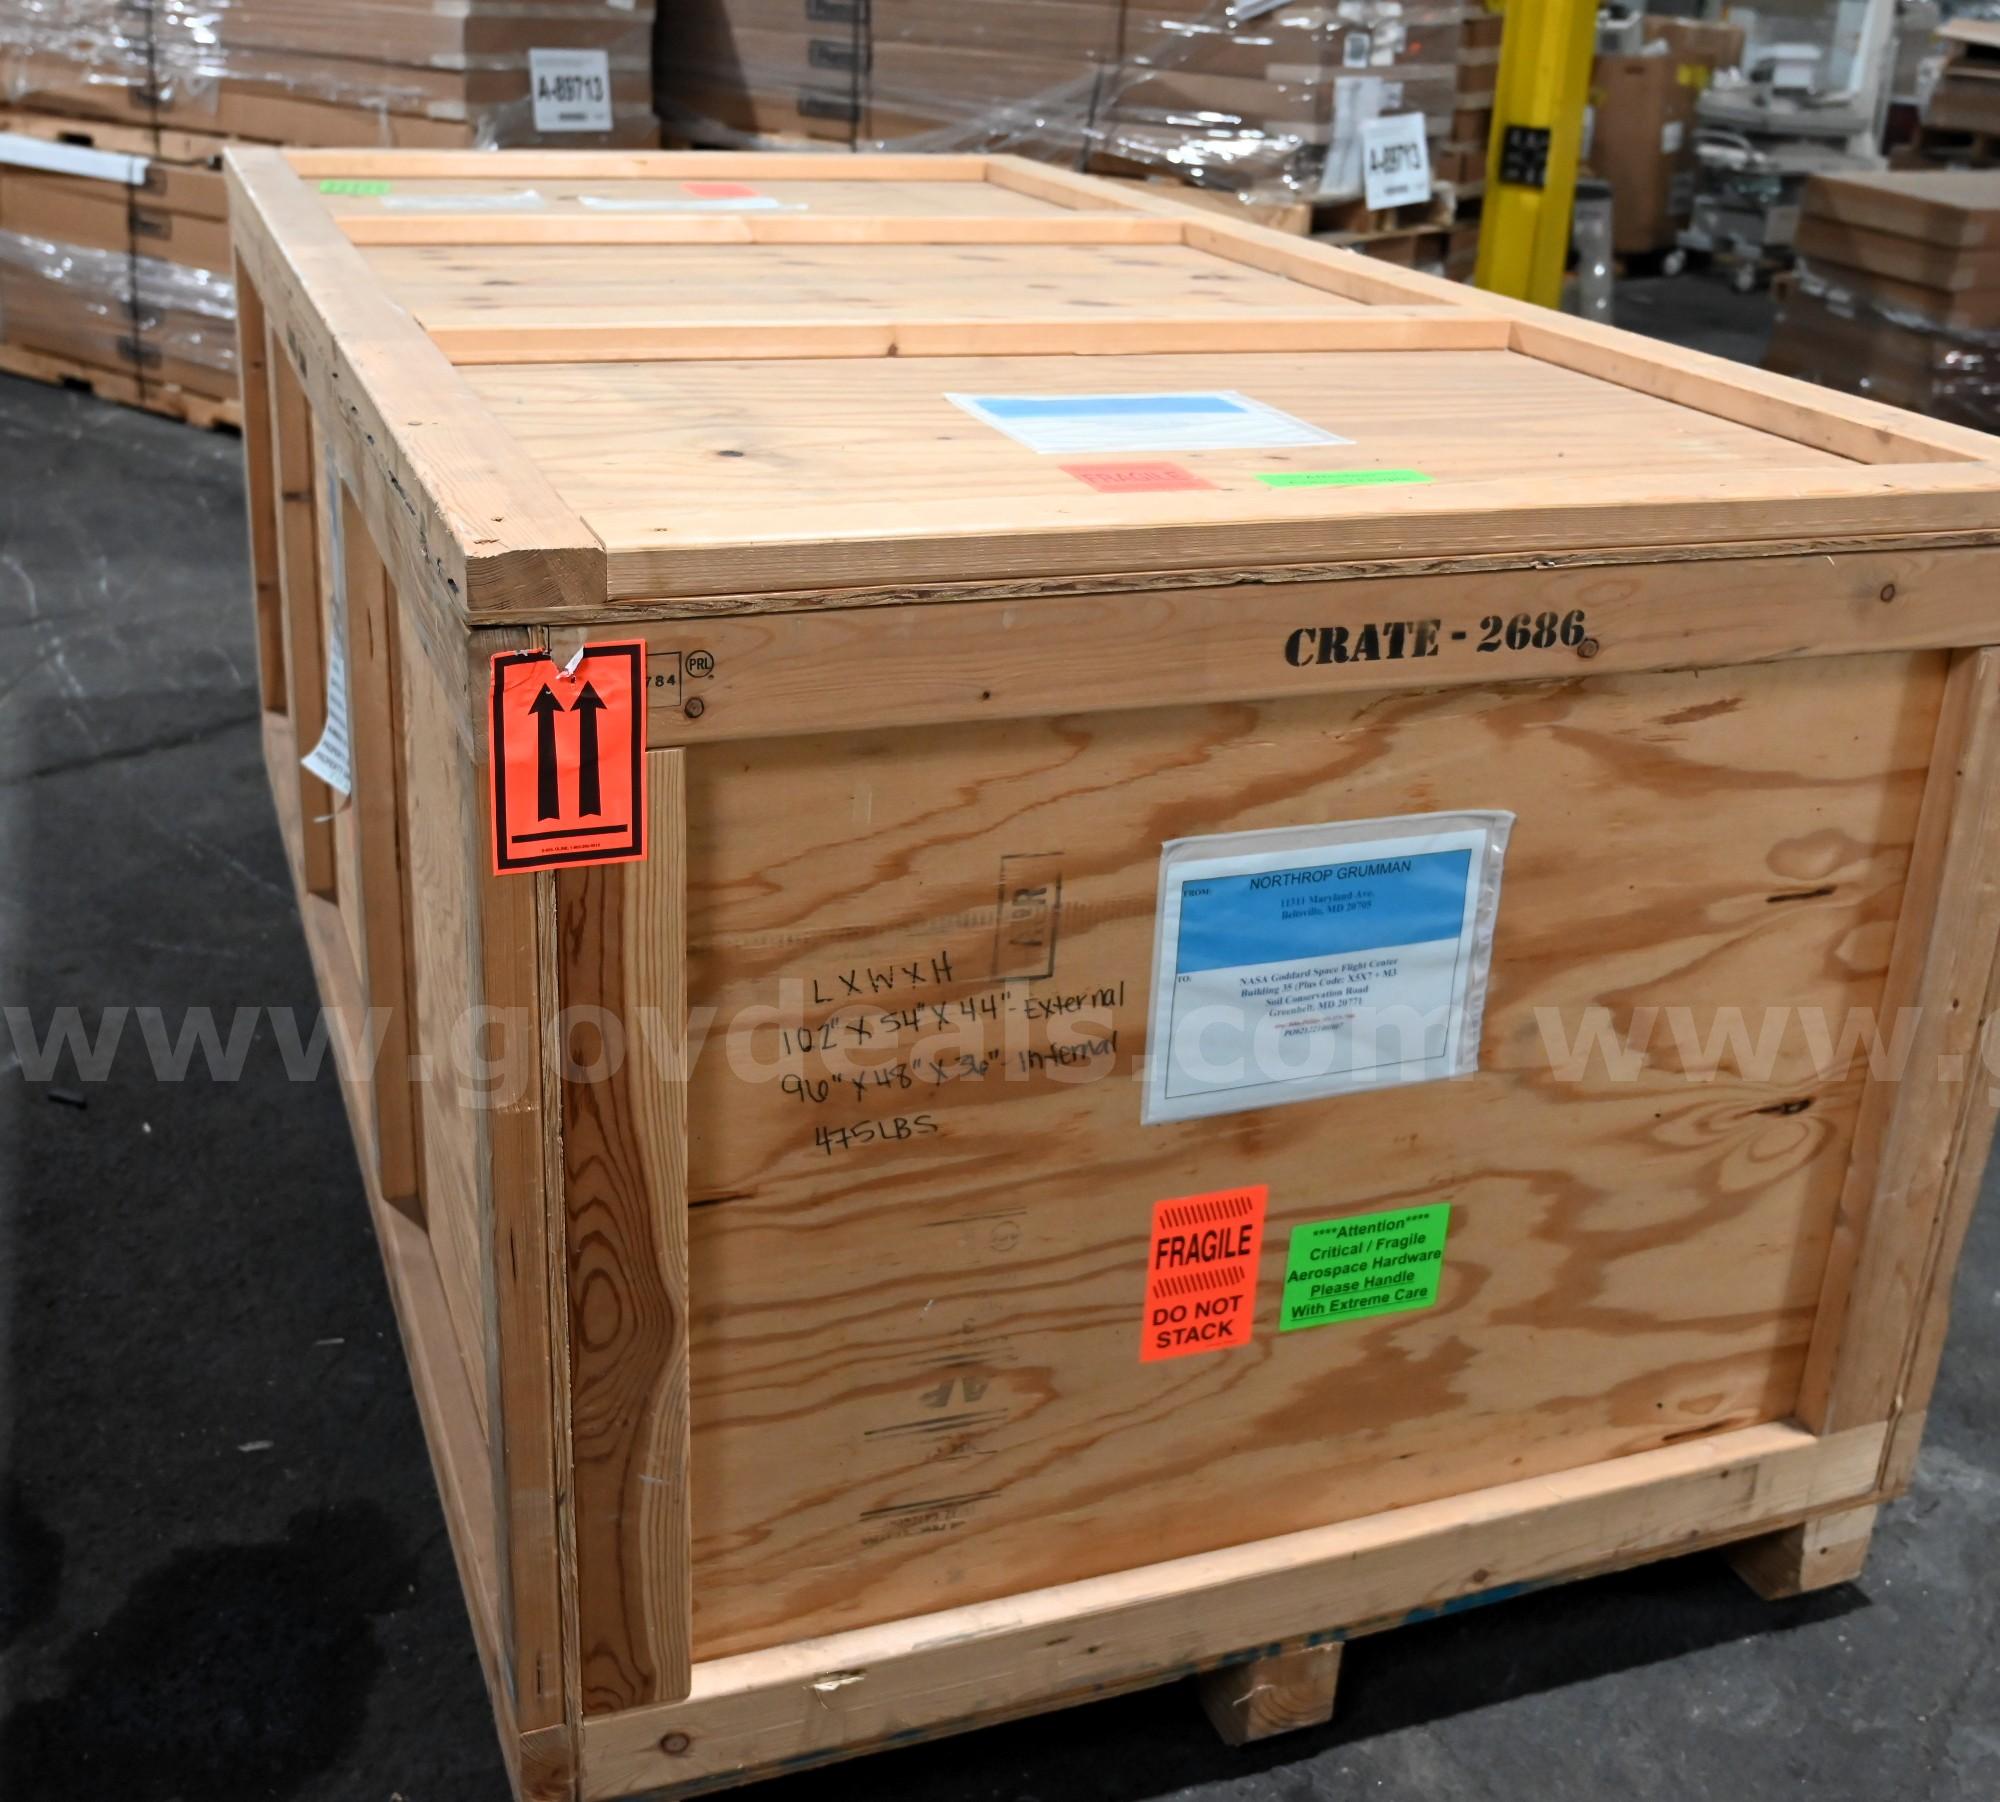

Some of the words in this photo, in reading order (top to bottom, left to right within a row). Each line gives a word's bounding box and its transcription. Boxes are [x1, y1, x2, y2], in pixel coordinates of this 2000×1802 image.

[1284, 618, 1441, 667] CRATE
[1476, 609, 1586, 652] 2686
[689, 658, 712, 670] PRL
[1249, 869, 1332, 890] NORTHROP
[1337, 860, 1412, 880] GRUMMAN
[1309, 891, 1353, 904] Maryland
[1327, 904, 1344, 913] MD
[1240, 976, 1268, 987] NASA
[1271, 969, 1311, 982] Goddard
[1314, 965, 1339, 978] Space
[1342, 961, 1367, 975] Flight
[1369, 958, 1398, 968] Center
[1241, 984, 1280, 998] Building
[1265, 996, 1283, 1007] Soil
[1285, 989, 1343, 1004] Conservation
[1346, 985, 1369, 995] Road
[1318, 1000, 1335, 1010] MD
[1155, 1224, 1254, 1270] FRAGILE
[1309, 1240, 1363, 1262] Critical
[1375, 1232, 1426, 1254] Fragile
[1287, 1261, 1368, 1283] Aerospace
[1372, 1249, 1442, 1270] Hardware
[1309, 1279, 1360, 1297] Please
[1364, 1270, 1415, 1288] Handle
[1152, 1304, 1187, 1326] DO
[1194, 1295, 1244, 1319] NOT
[1290, 1302, 1326, 1319] With
[1329, 1293, 1391, 1313] Extreme
[1394, 1286, 1428, 1301] Care
[1156, 1319, 1233, 1349] STACK
